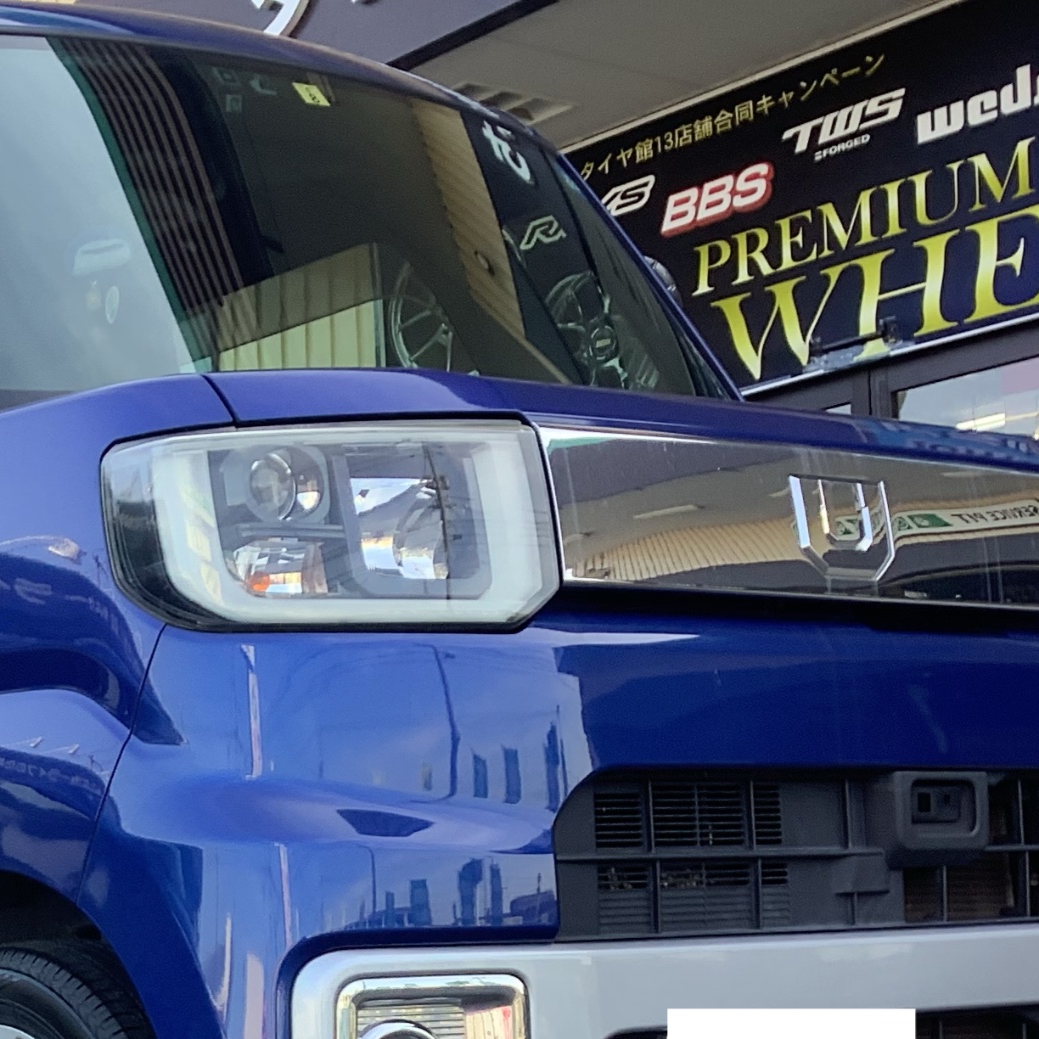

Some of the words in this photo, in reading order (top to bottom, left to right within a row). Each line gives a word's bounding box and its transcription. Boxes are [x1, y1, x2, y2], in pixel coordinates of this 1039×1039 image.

[580, 53, 886, 181] タイヤ館13店舗合同キャンペーン
[781, 87, 906, 154] TWS
[917, 64, 1039, 145] wed
[821, 134, 871, 160] FORGED
[661, 162, 774, 237] BBS
[692, 136, 1037, 297] PREMIUM
